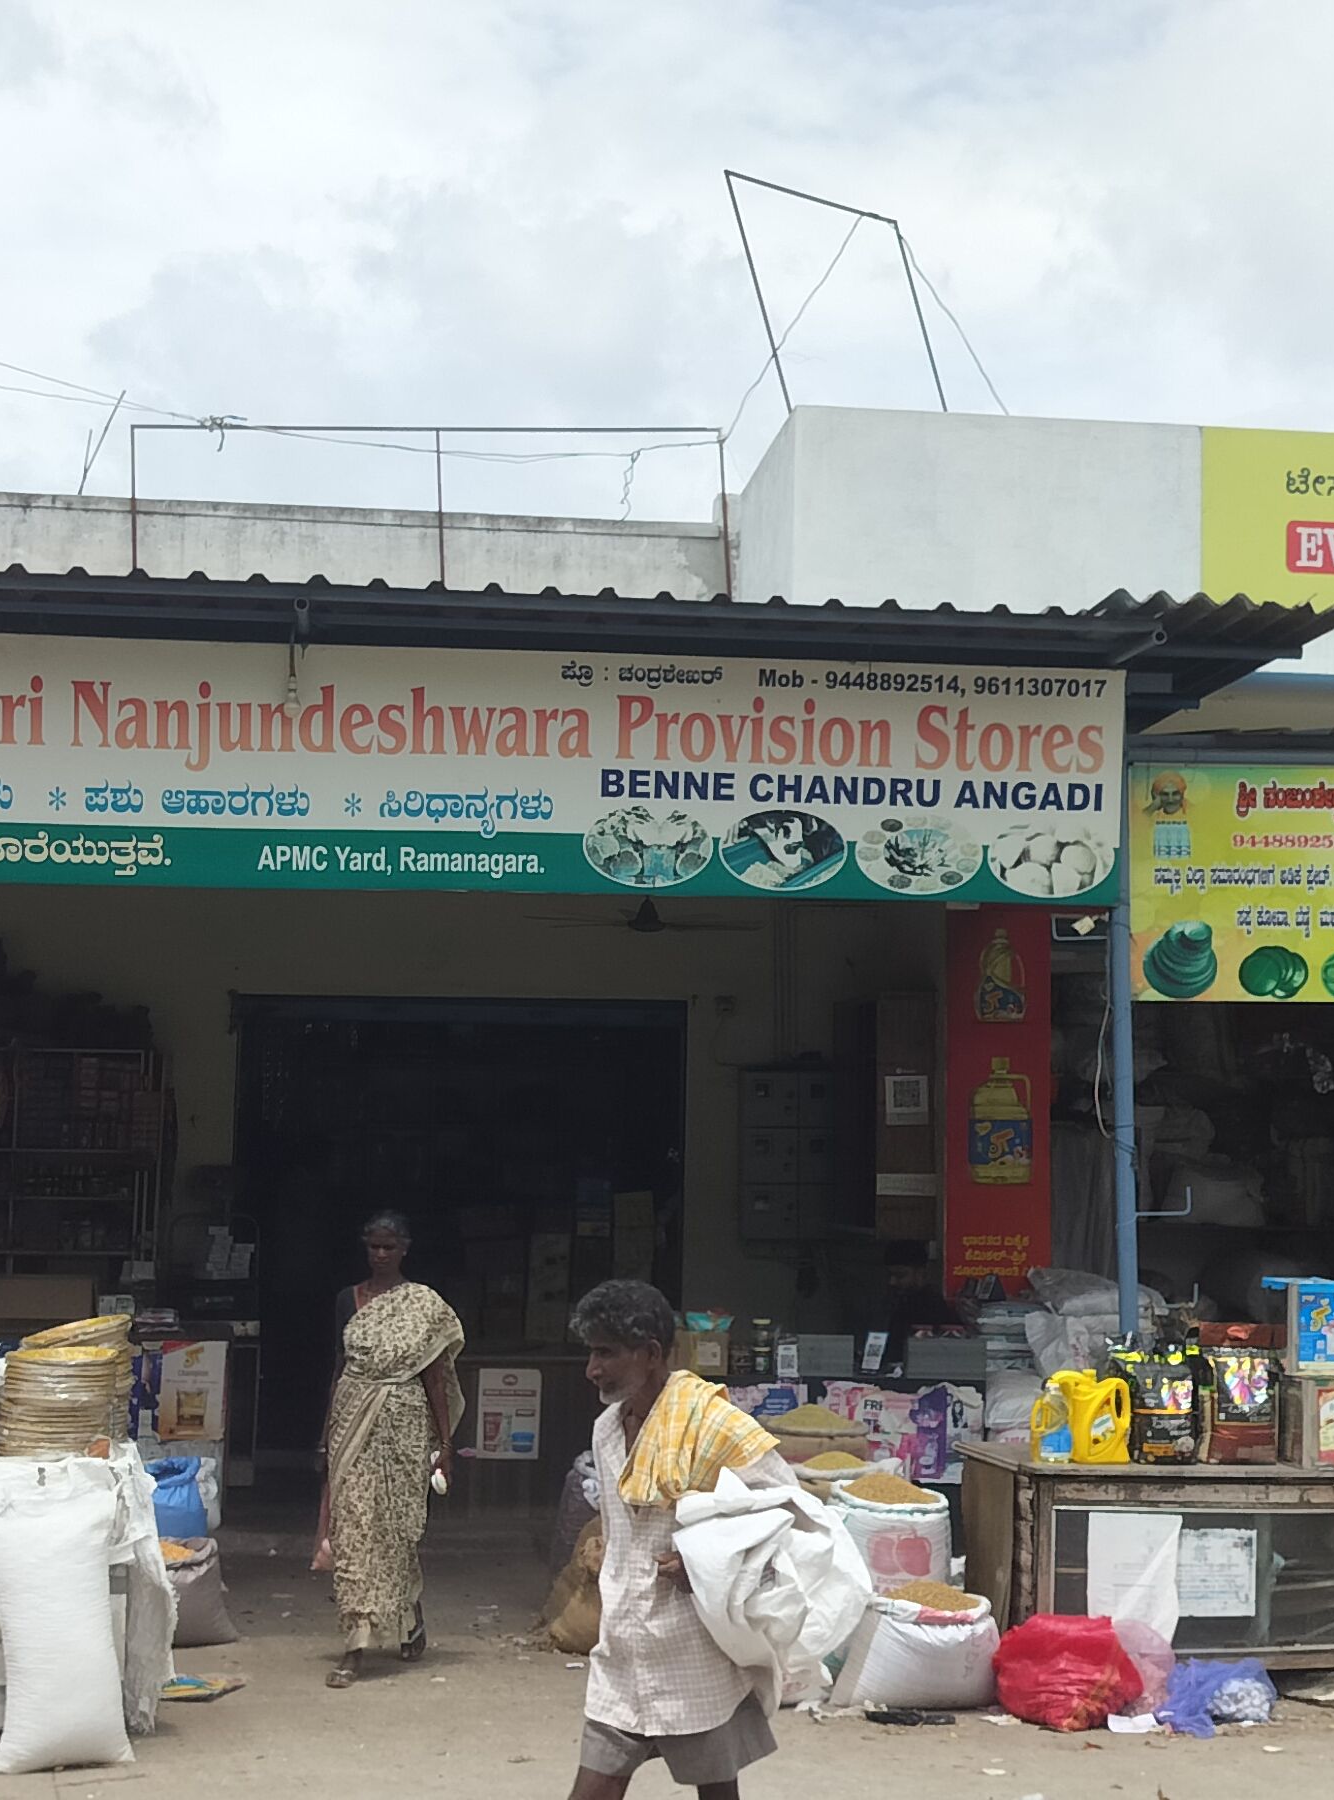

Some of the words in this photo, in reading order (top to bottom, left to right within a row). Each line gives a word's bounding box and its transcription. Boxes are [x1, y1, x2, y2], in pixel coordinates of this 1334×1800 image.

[758, 668, 805, 689] Mob
[825, 670, 967, 699] 9448892514,
[973, 675, 1107, 698] 9611307017
[70, 680, 593, 772] Nanjundeshwara
[615, 694, 893, 768] Provision
[914, 702, 1105, 775] Stores
[84, 778, 144, 815] ಪಶು
[161, 783, 311, 818] ಆಹಾರಗಳು
[379, 786, 555, 838] ಸಿರಿಧಾನ್ಯಗಳು
[600, 768, 736, 801] BENNE
[749, 772, 942, 809] CHANDRU
[953, 779, 1104, 812] ANGADI
[257, 845, 328, 873] APMC
[335, 846, 392, 875] Yard,
[399, 848, 546, 878] Ramanagara.
